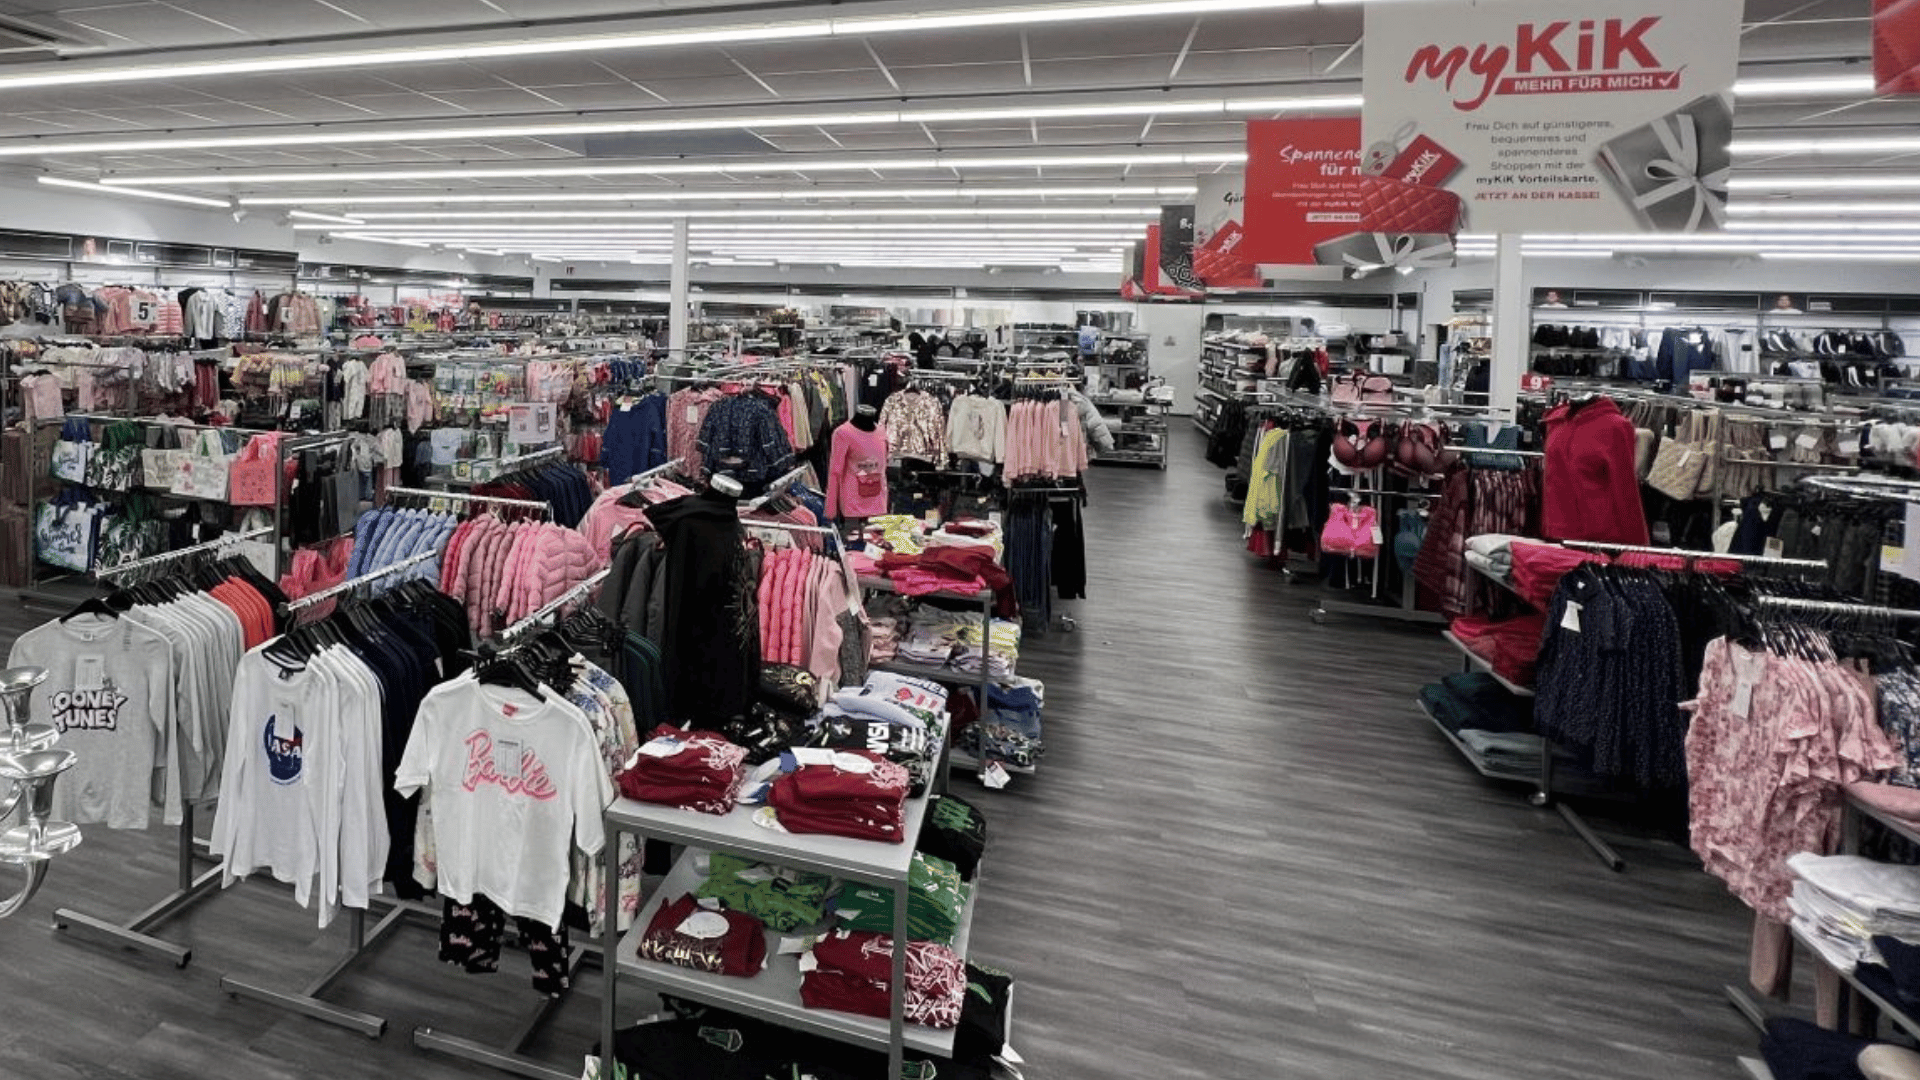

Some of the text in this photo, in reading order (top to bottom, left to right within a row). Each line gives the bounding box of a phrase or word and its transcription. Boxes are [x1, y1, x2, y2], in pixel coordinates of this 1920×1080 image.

[1405, 15, 1664, 112] myKiK
[1514, 75, 1654, 92] MEHR FÜR MICH
[1465, 121, 1490, 131] Freu
[1493, 120, 1519, 130] Dich
[1522, 120, 1540, 129] auf
[1491, 133, 1587, 144] bequemeres und
[1498, 148, 1578, 158] spannenderes
[1320, 162, 1348, 176] für
[1490, 160, 1586, 172] Shoppen mit der
[1476, 175, 1515, 186] myKiK
[1474, 191, 1600, 201] JETZT AN DER KASSE!
[138, 302, 149, 321] 5
[54, 708, 118, 734] TUNES
[462, 728, 558, 801] Babie
